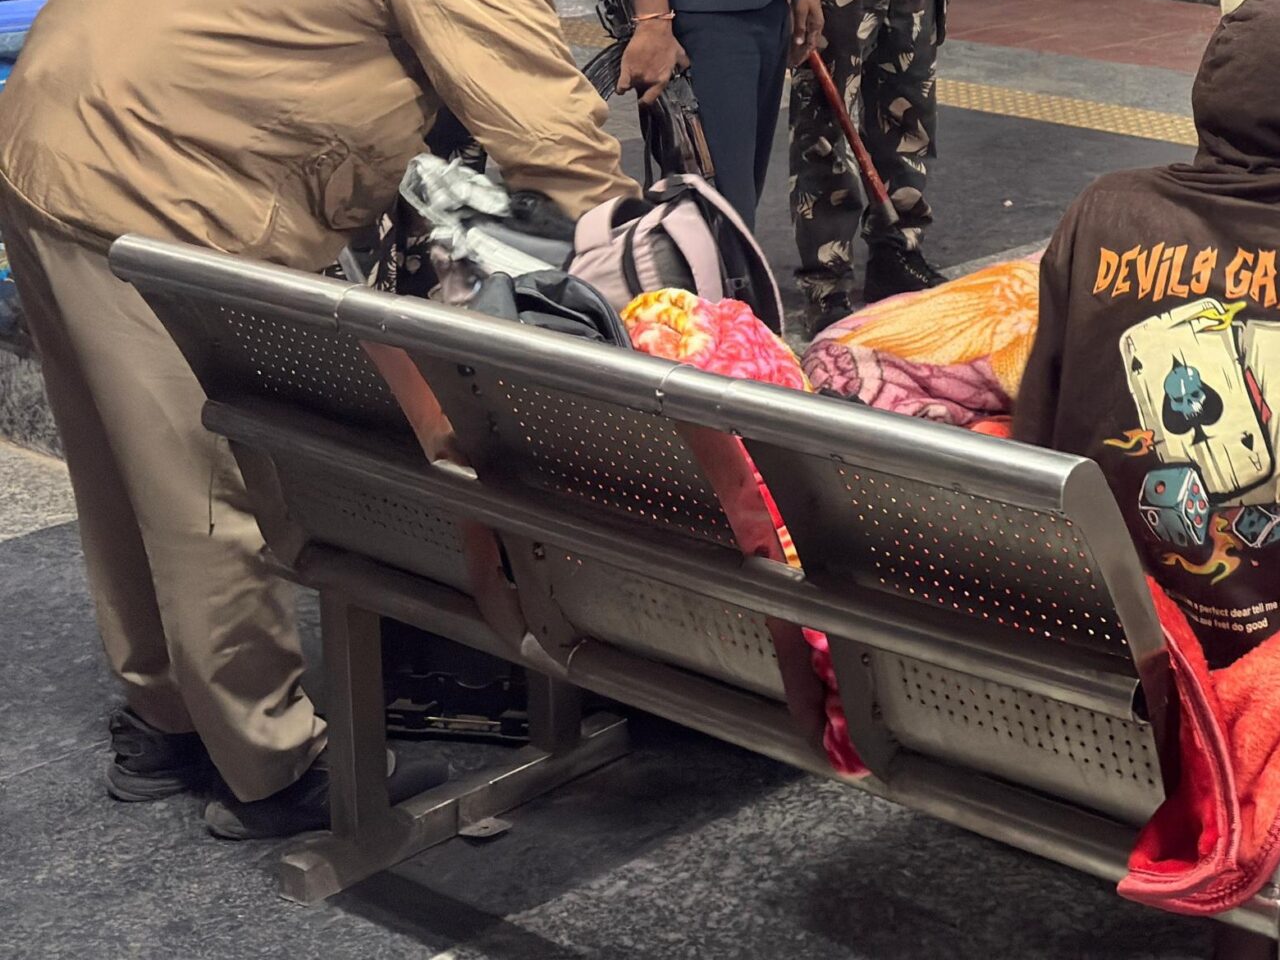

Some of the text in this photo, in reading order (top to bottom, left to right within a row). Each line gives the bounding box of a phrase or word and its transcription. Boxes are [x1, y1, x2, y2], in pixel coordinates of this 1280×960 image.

[1230, 605, 1251, 618] dear
[1252, 602, 1264, 614] tell
[1265, 601, 1278, 612] me
[1231, 623, 1244, 632] do
[1246, 618, 1268, 633] good
